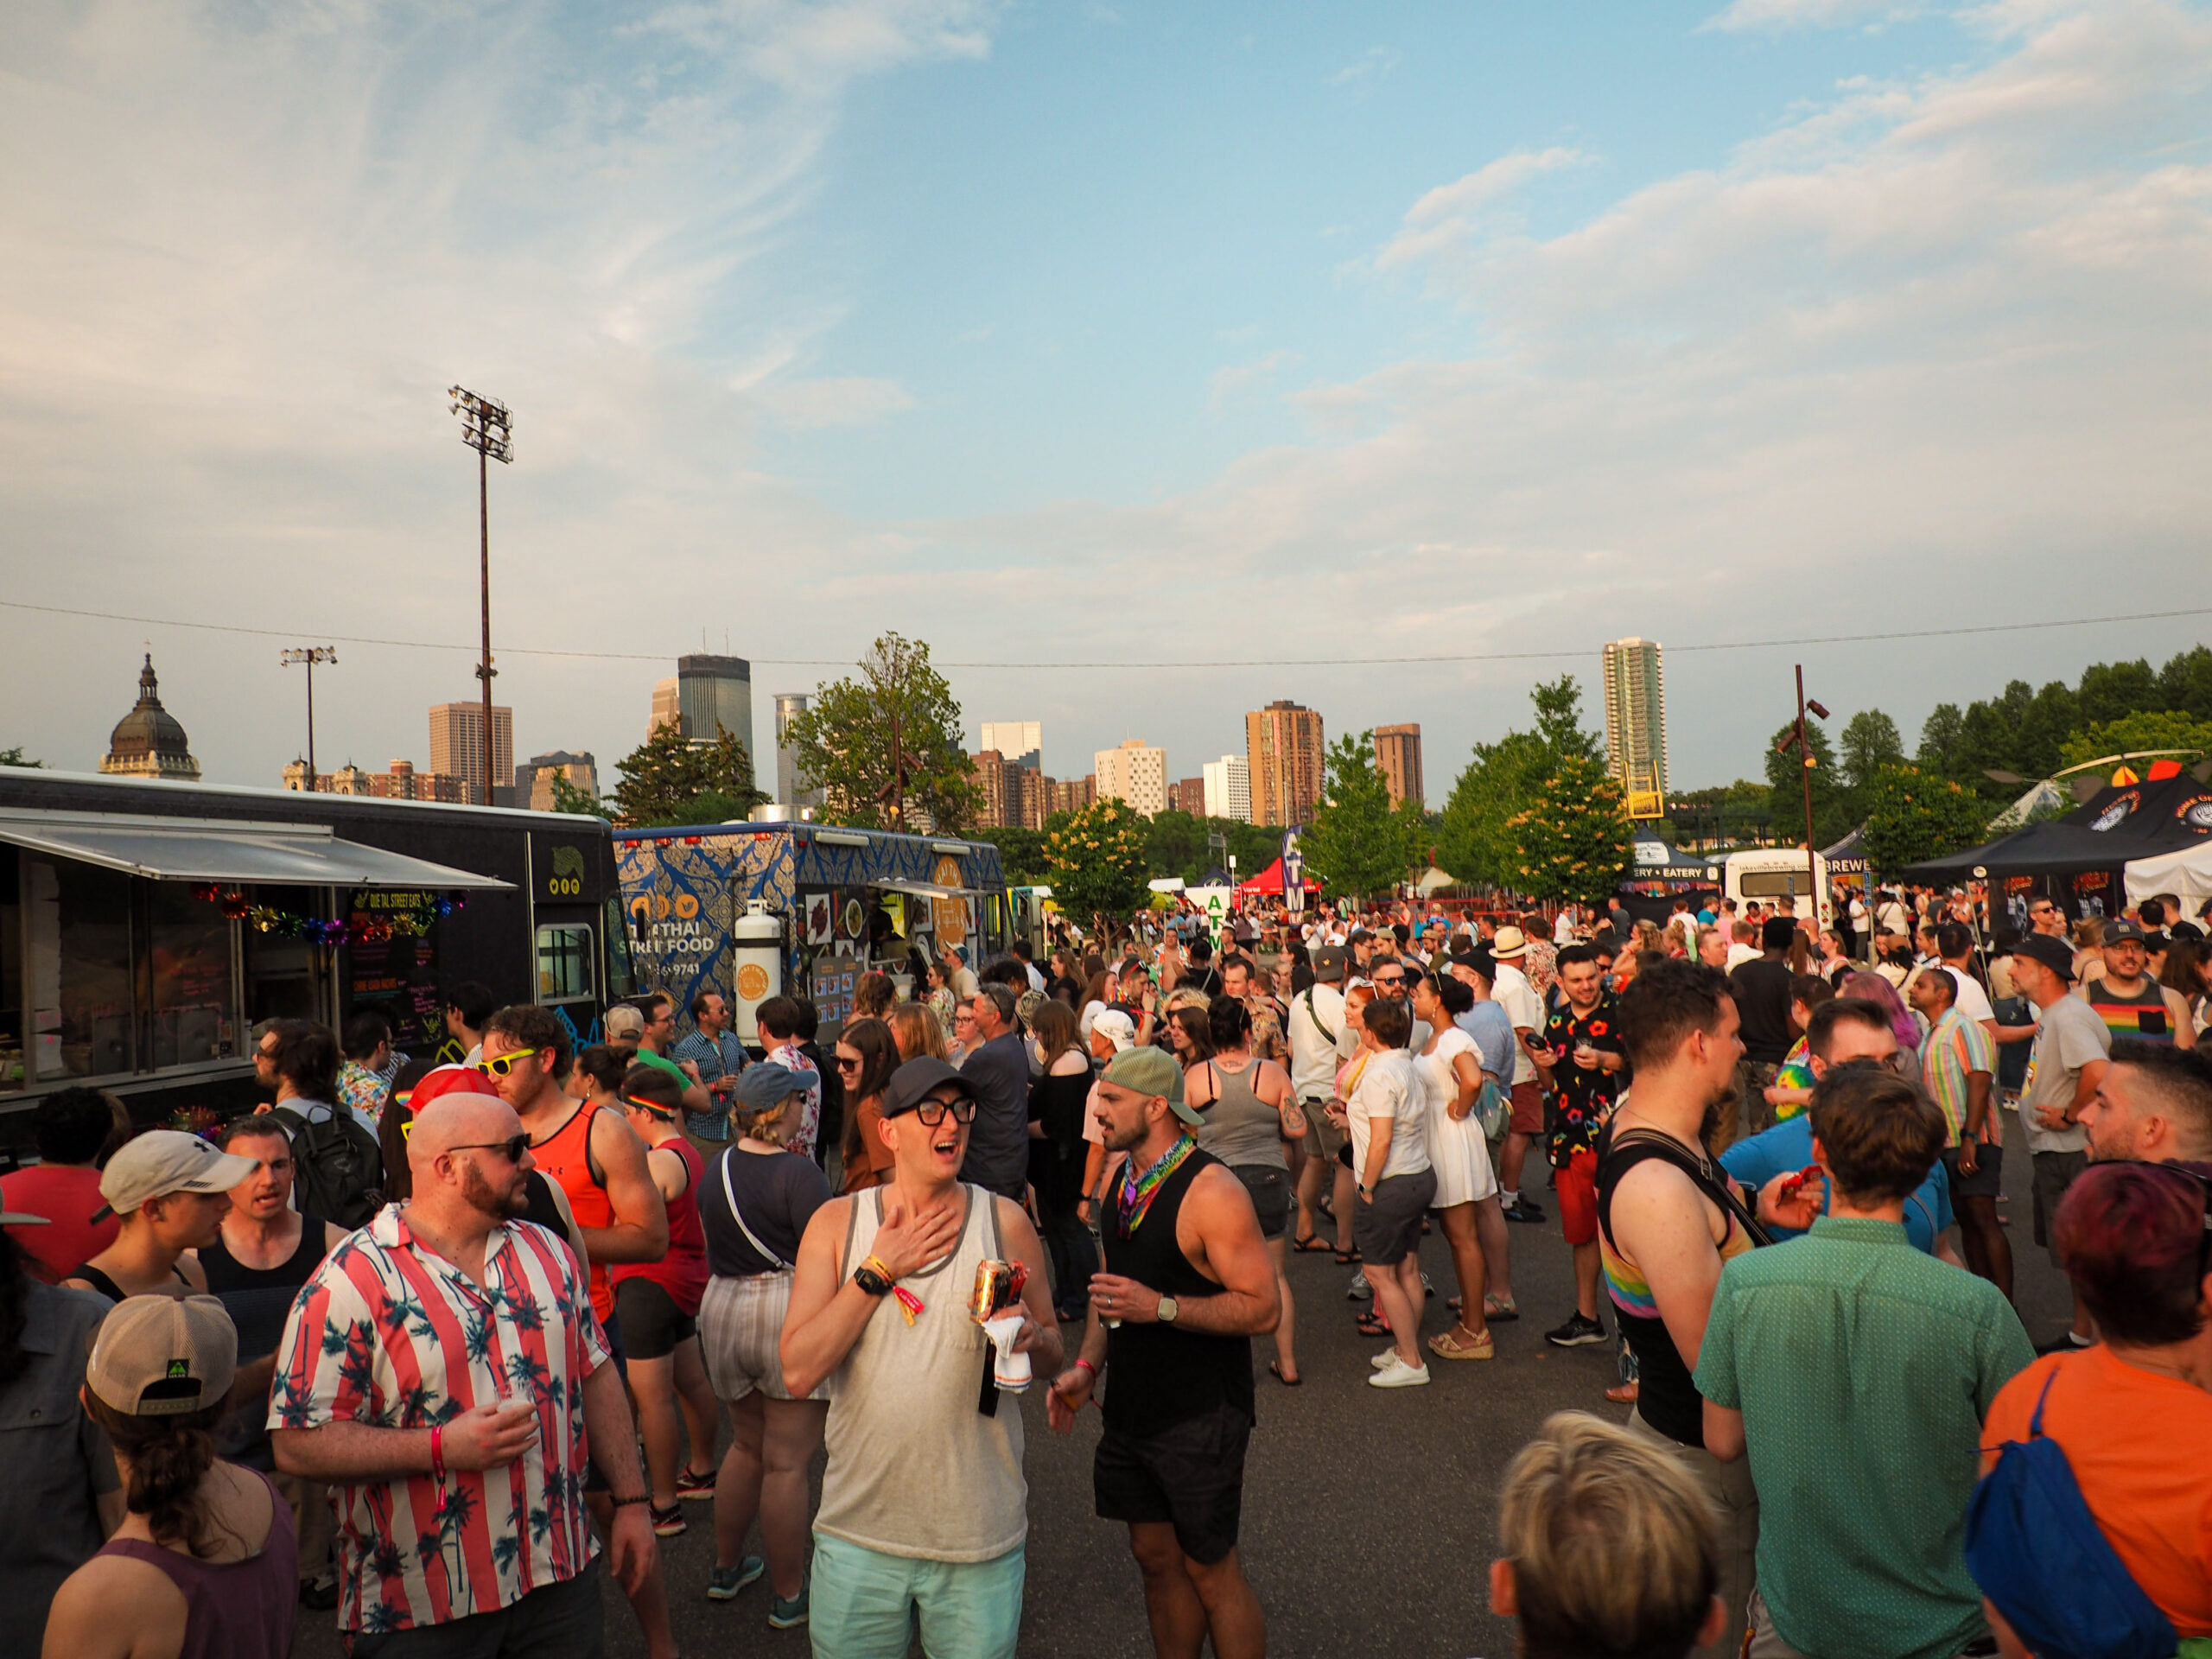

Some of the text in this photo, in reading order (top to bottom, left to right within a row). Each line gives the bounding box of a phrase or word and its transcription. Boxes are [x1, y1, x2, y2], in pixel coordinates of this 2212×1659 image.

[1662, 868, 1702, 878] EATERY
[370, 893, 421, 908] QUE TAL STREET EATS
[1207, 895, 1224, 951] ATM
[667, 938, 715, 953] FOOD
